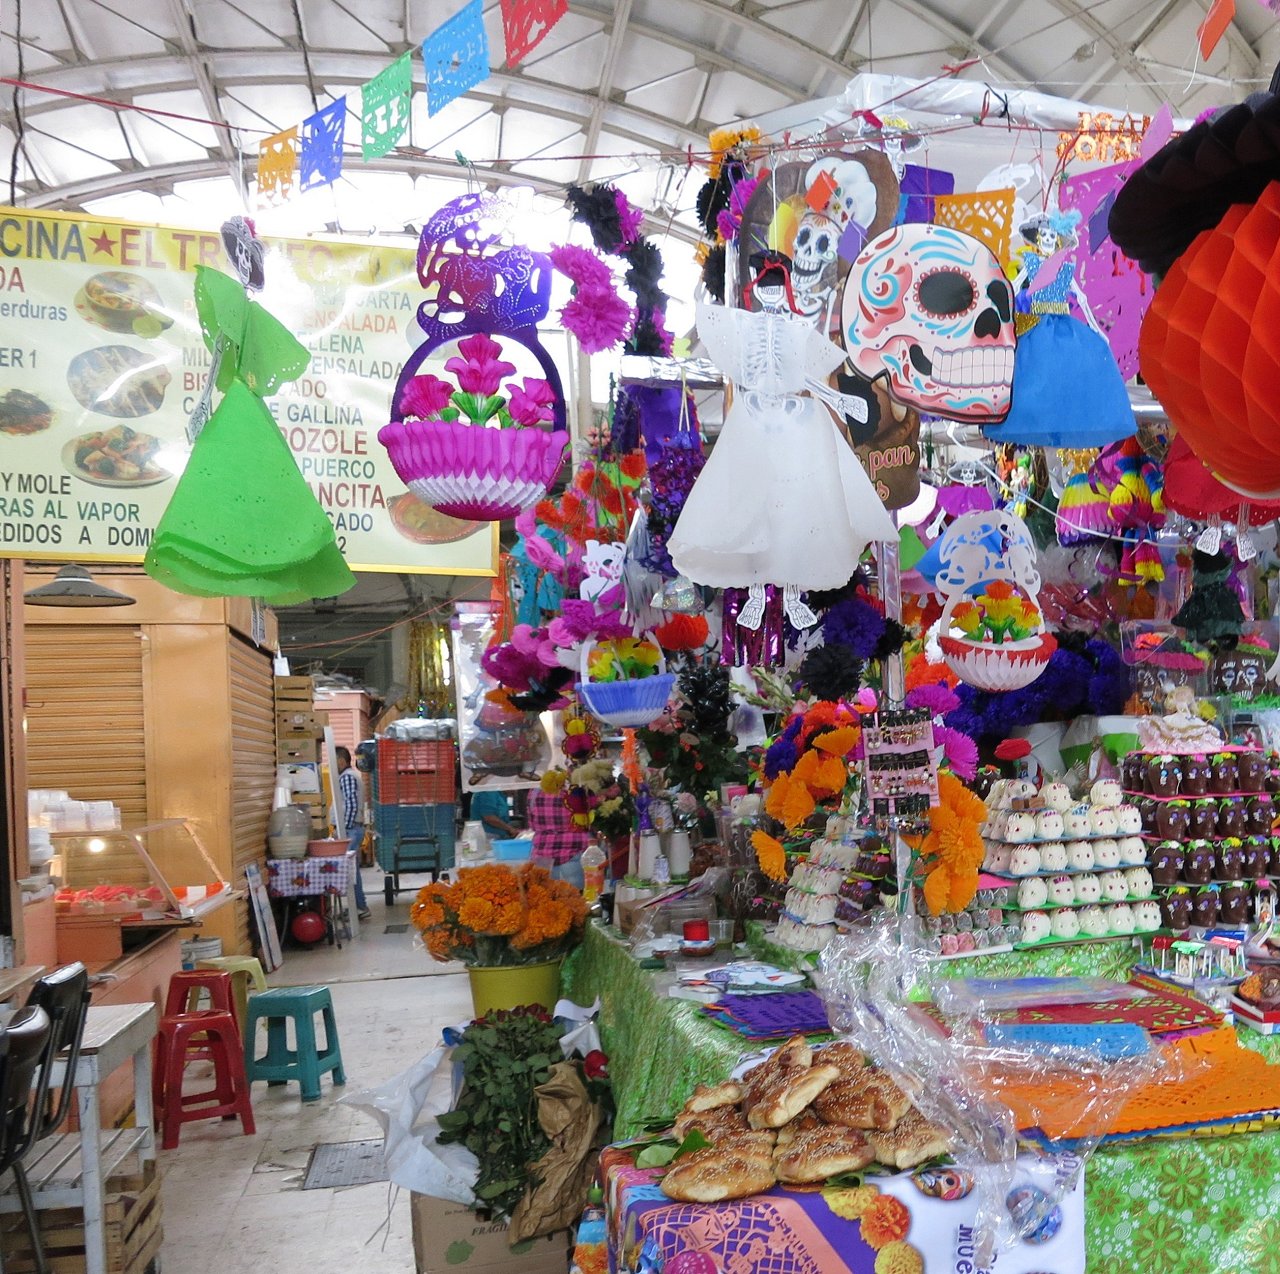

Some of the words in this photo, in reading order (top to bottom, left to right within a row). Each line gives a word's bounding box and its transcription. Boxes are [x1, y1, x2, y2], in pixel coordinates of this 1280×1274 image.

[0, 218, 86, 262] CINA
[121, 228, 166, 269] EL
[1, 299, 67, 321] erduras
[287, 403, 363, 426] GALLINA
[302, 457, 376, 479] PUERCO
[869, 445, 916, 480] pan
[2, 472, 14, 491] Y
[18, 474, 71, 495] MOLE
[43, 499, 68, 519] AL
[77, 501, 140, 522] VAPOR
[79, 526, 92, 545] A
